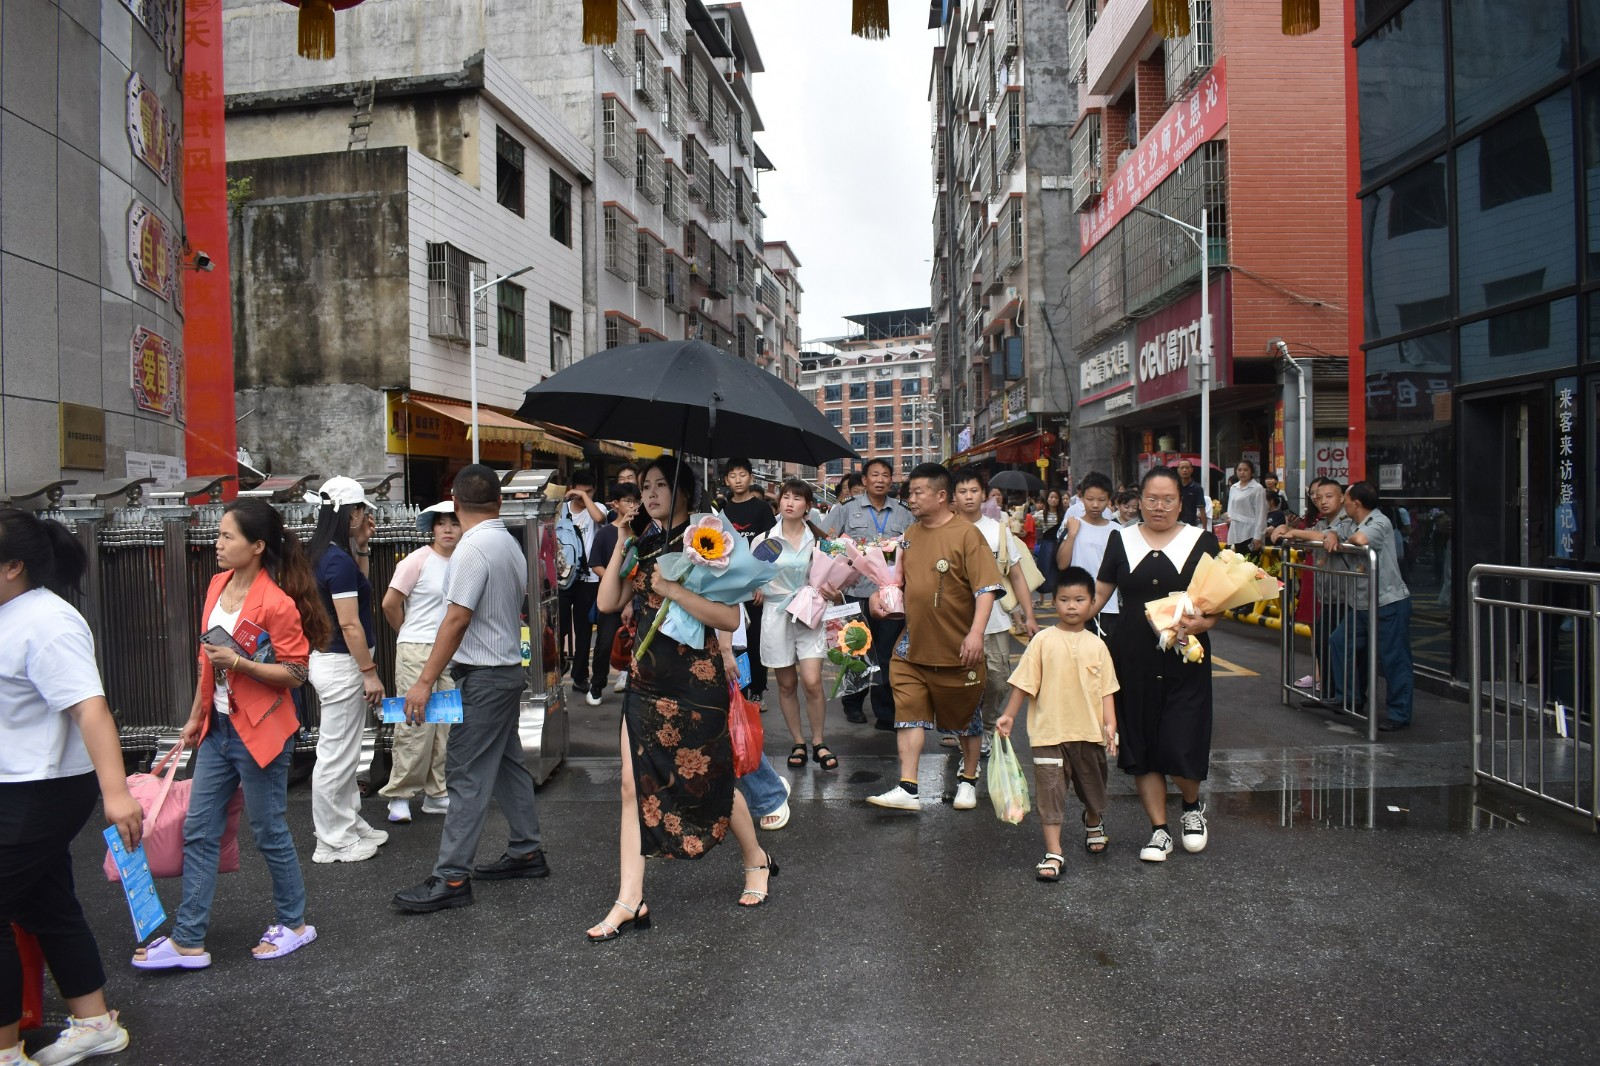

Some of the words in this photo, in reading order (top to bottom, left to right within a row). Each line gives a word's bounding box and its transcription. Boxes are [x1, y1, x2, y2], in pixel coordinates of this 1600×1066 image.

[140, 227, 168, 291] 自由
[142, 350, 168, 404] 爱国
[1140, 333, 1167, 383] deli
[1559, 387, 1574, 553] 来客来访登记处
